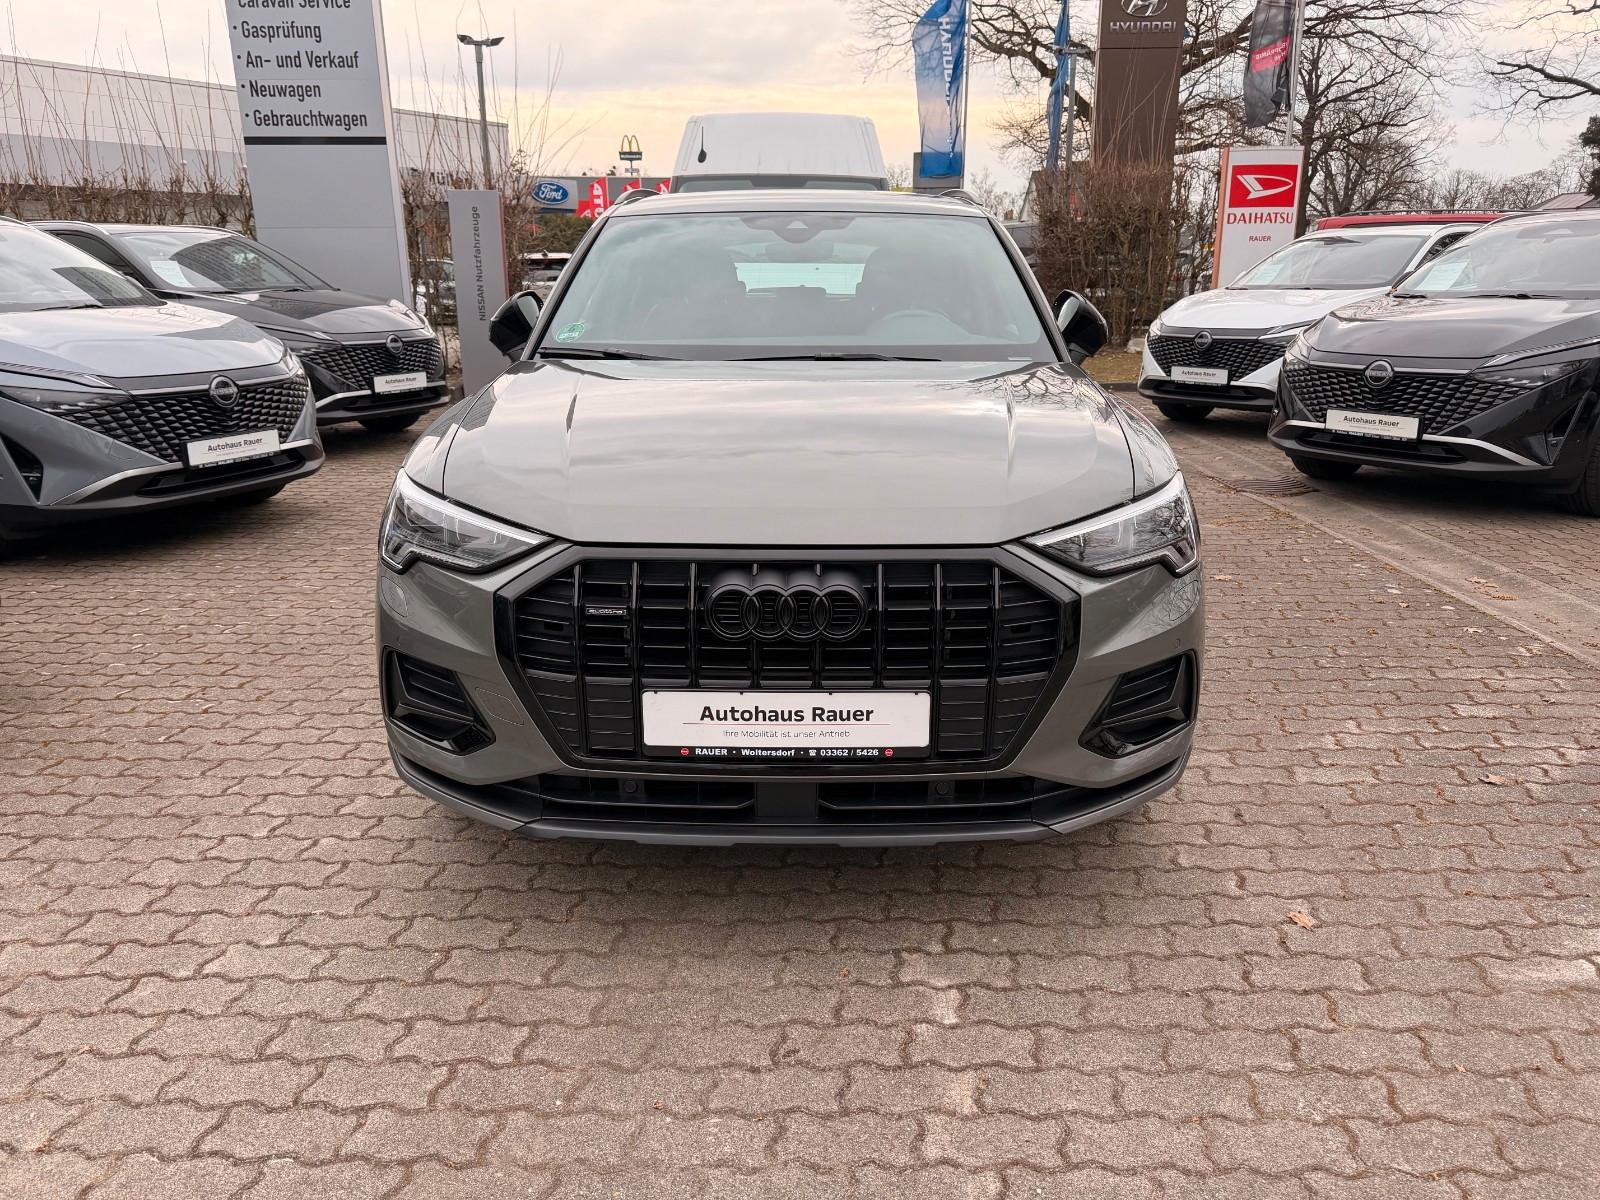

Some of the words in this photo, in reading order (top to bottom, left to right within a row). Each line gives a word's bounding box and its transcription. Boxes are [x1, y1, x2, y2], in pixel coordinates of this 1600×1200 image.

[241, 21, 322, 43] Gasprüfung
[1110, 21, 1177, 33] HYUNDAI
[246, 51, 271, 68] An-
[276, 50, 302, 68] und
[305, 51, 359, 68] Verkauf
[249, 80, 321, 102] Neuwagen
[253, 109, 368, 131] Gebrauchtwagen
[539, 183, 563, 200] Ford
[1226, 212, 1294, 224] DAIHATSU
[472, 206, 482, 282] Nutzfahrzeuge
[476, 285, 486, 321] NISSAN
[1343, 415, 1377, 425] Autohaus
[1378, 419, 1400, 427] Rauer
[207, 441, 242, 452] Autohaus
[243, 437, 263, 446] Rauer
[700, 705, 805, 722] Autohaus
[812, 706, 874, 722] Rauer
[723, 730, 739, 738] Ihre
[741, 730, 779, 738] Mobilität
[780, 730, 793, 738] ist
[819, 730, 851, 738] Antrieb
[695, 748, 728, 756] RAUER
[741, 748, 795, 757] Woltersdorf
[820, 749, 848, 757] 03362
[856, 749, 879, 757] 5426
